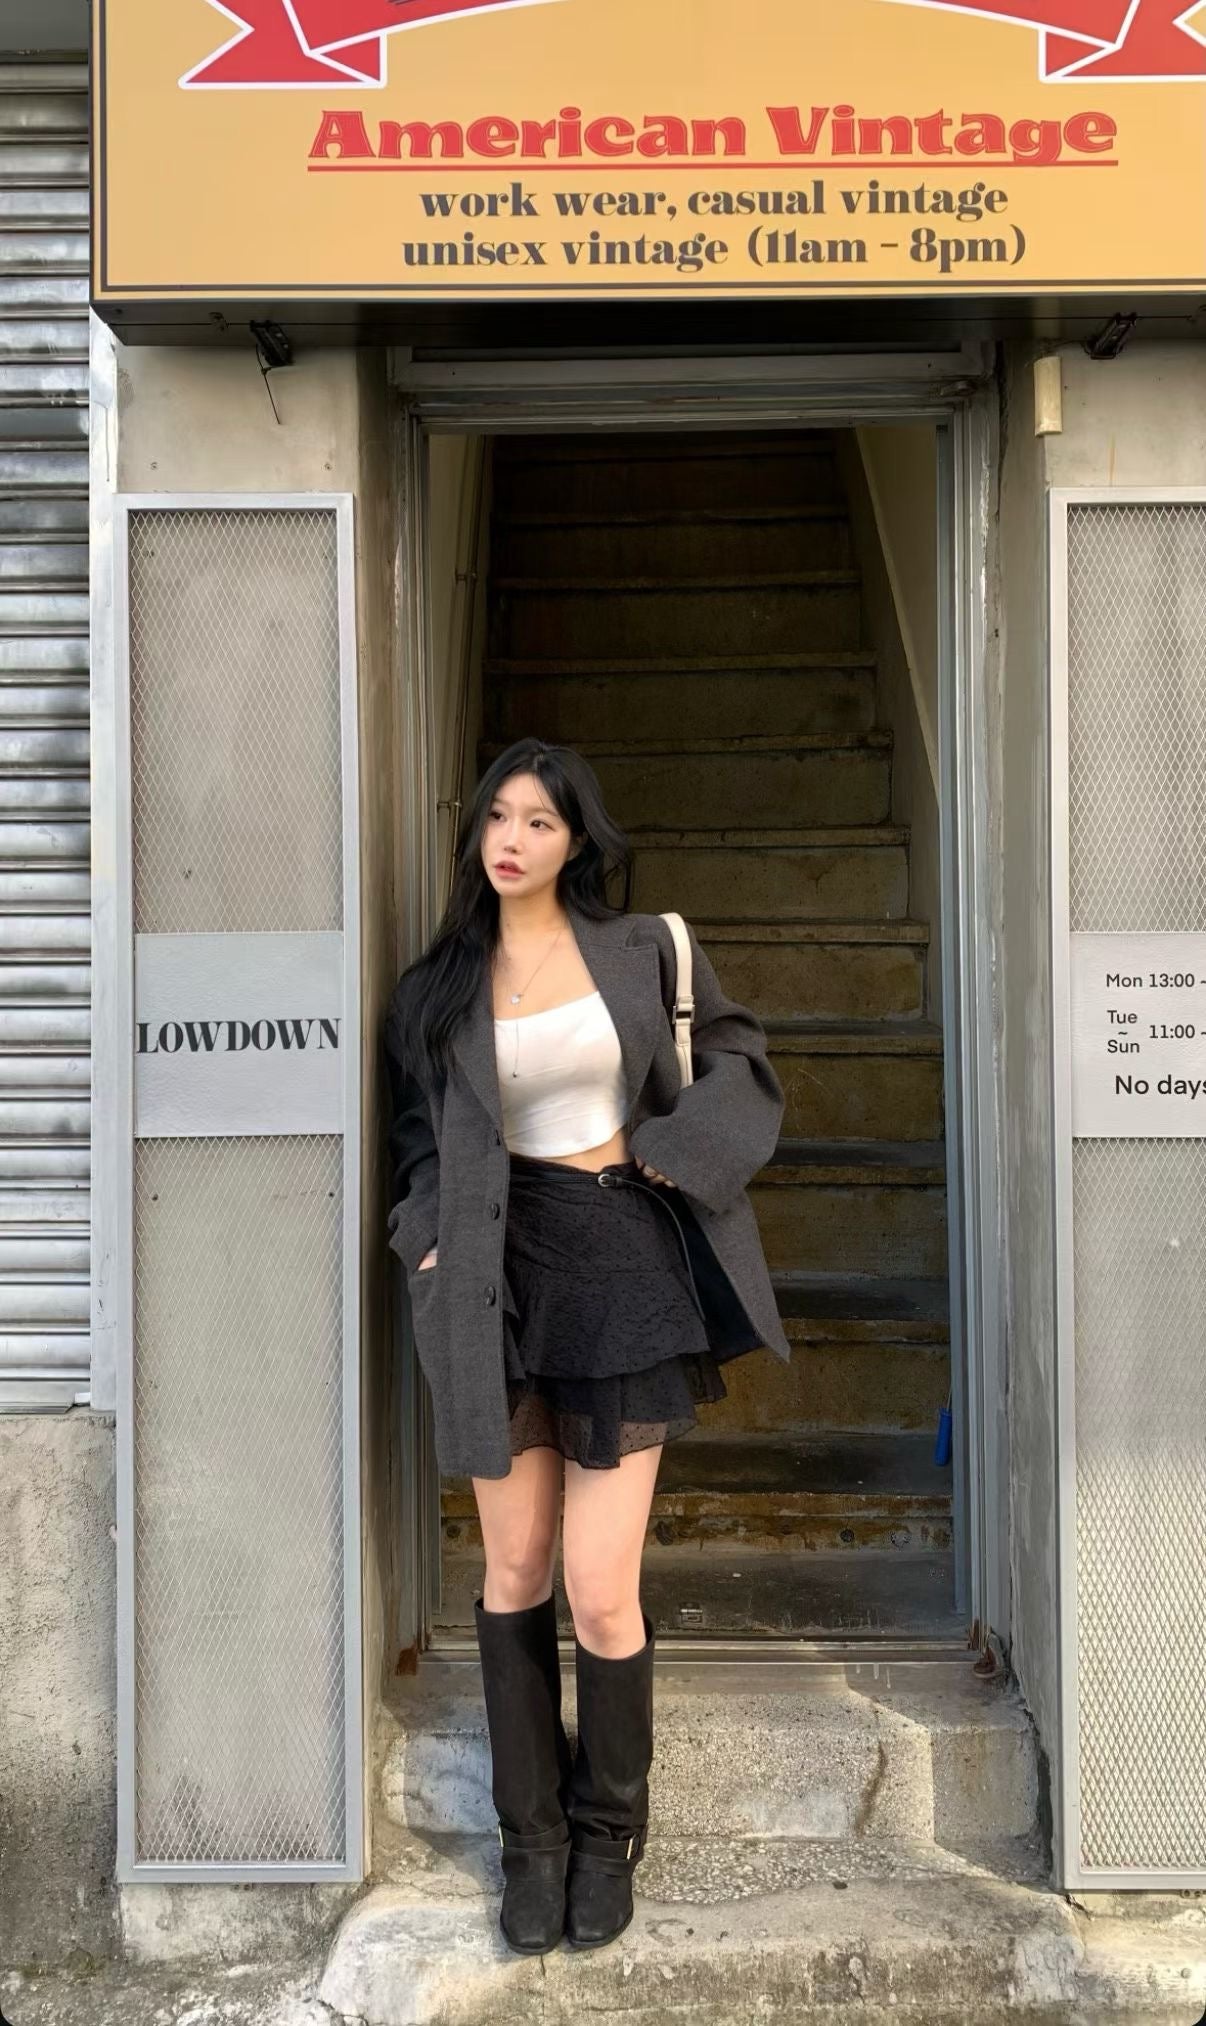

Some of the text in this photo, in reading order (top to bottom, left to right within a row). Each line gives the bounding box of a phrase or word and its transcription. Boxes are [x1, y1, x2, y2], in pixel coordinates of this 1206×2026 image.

[308, 104, 1117, 163] American Vintage
[419, 180, 1008, 222] work wear, casual vintage
[403, 232, 547, 267] unisex
[561, 231, 728, 272] vintage
[748, 225, 867, 266] (11am
[910, 224, 1026, 273] 8pm)
[1106, 973, 1143, 988] Mon
[1149, 973, 1195, 988] 13:00
[1107, 1010, 1138, 1025] Tue
[137, 1018, 341, 1053] LOWDOWN
[1149, 1024, 1196, 1039] 11:00
[1107, 1039, 1141, 1054] Sun
[1115, 1074, 1149, 1095] No
